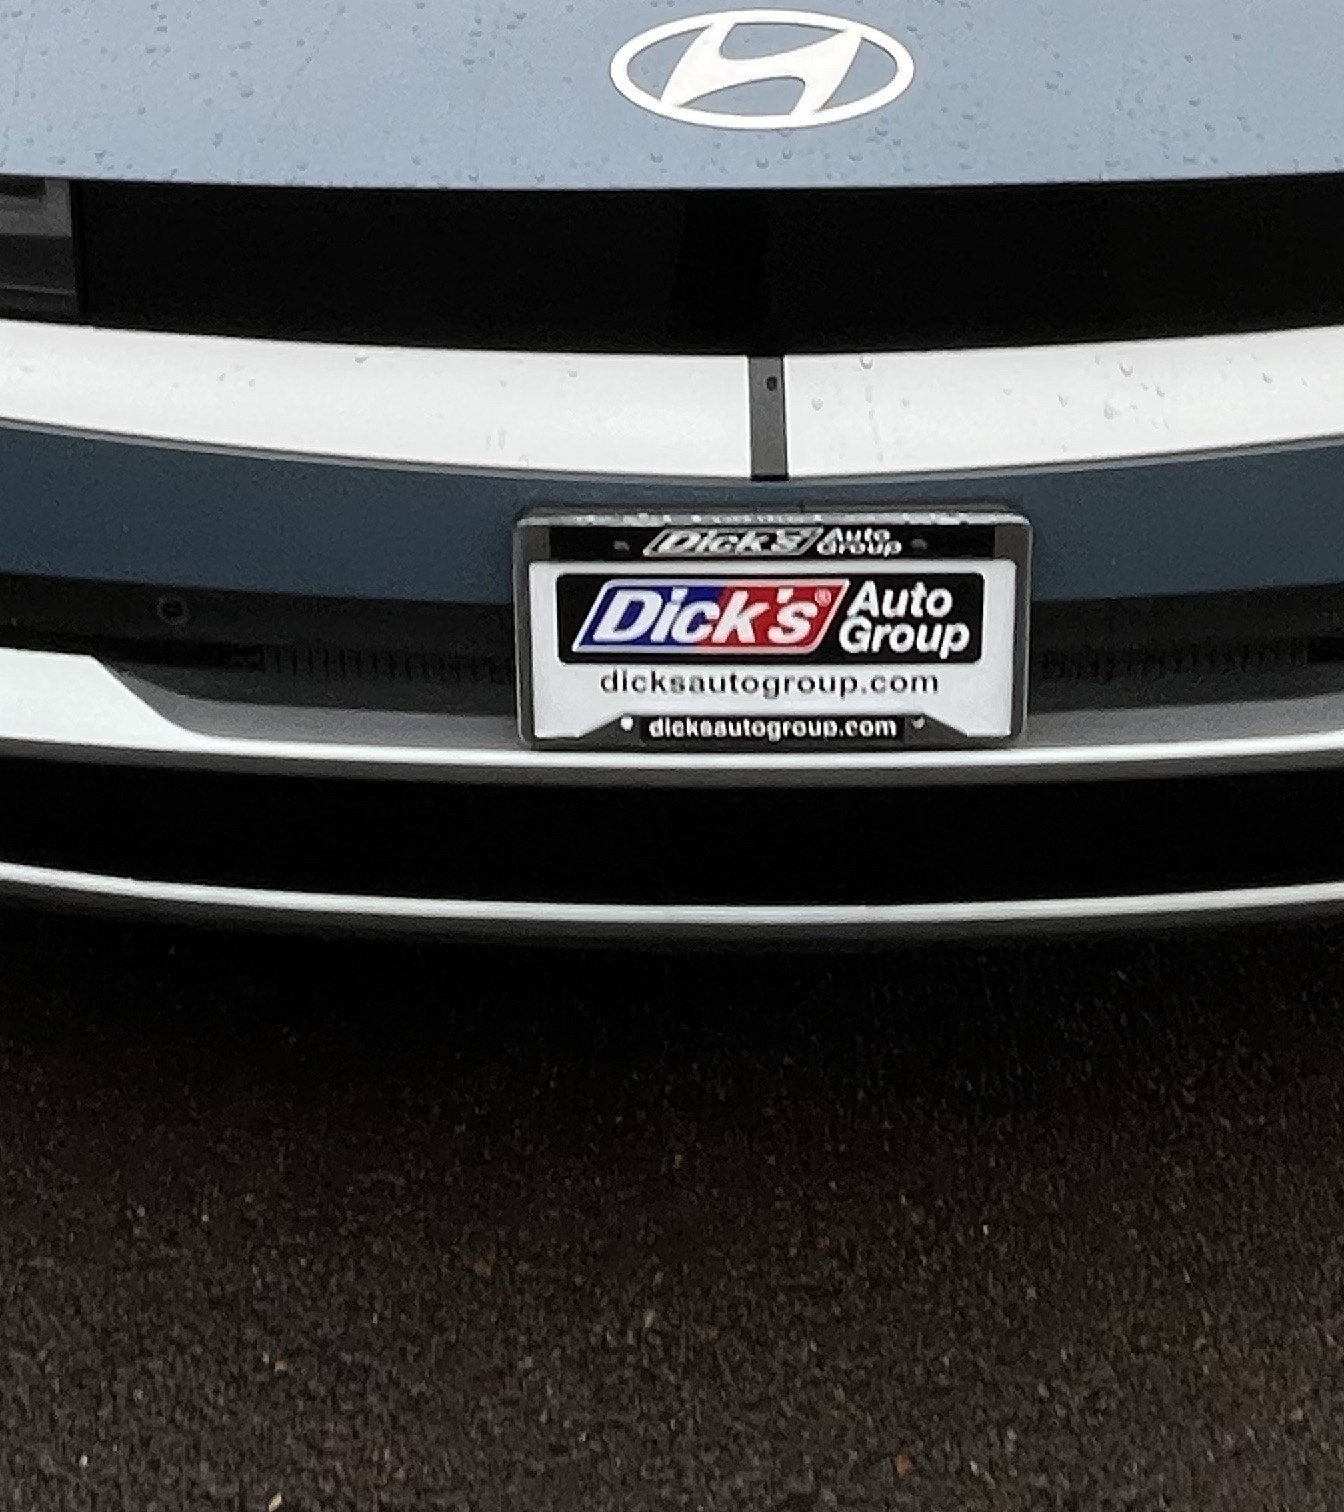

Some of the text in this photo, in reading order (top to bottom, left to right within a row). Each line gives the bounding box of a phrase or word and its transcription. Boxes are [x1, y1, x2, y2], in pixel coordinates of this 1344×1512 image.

[847, 581, 953, 619] Auto
[839, 619, 971, 658] Group
[600, 669, 939, 699] dicksautogroup.com
[648, 717, 897, 741] dicksautogroup.com
